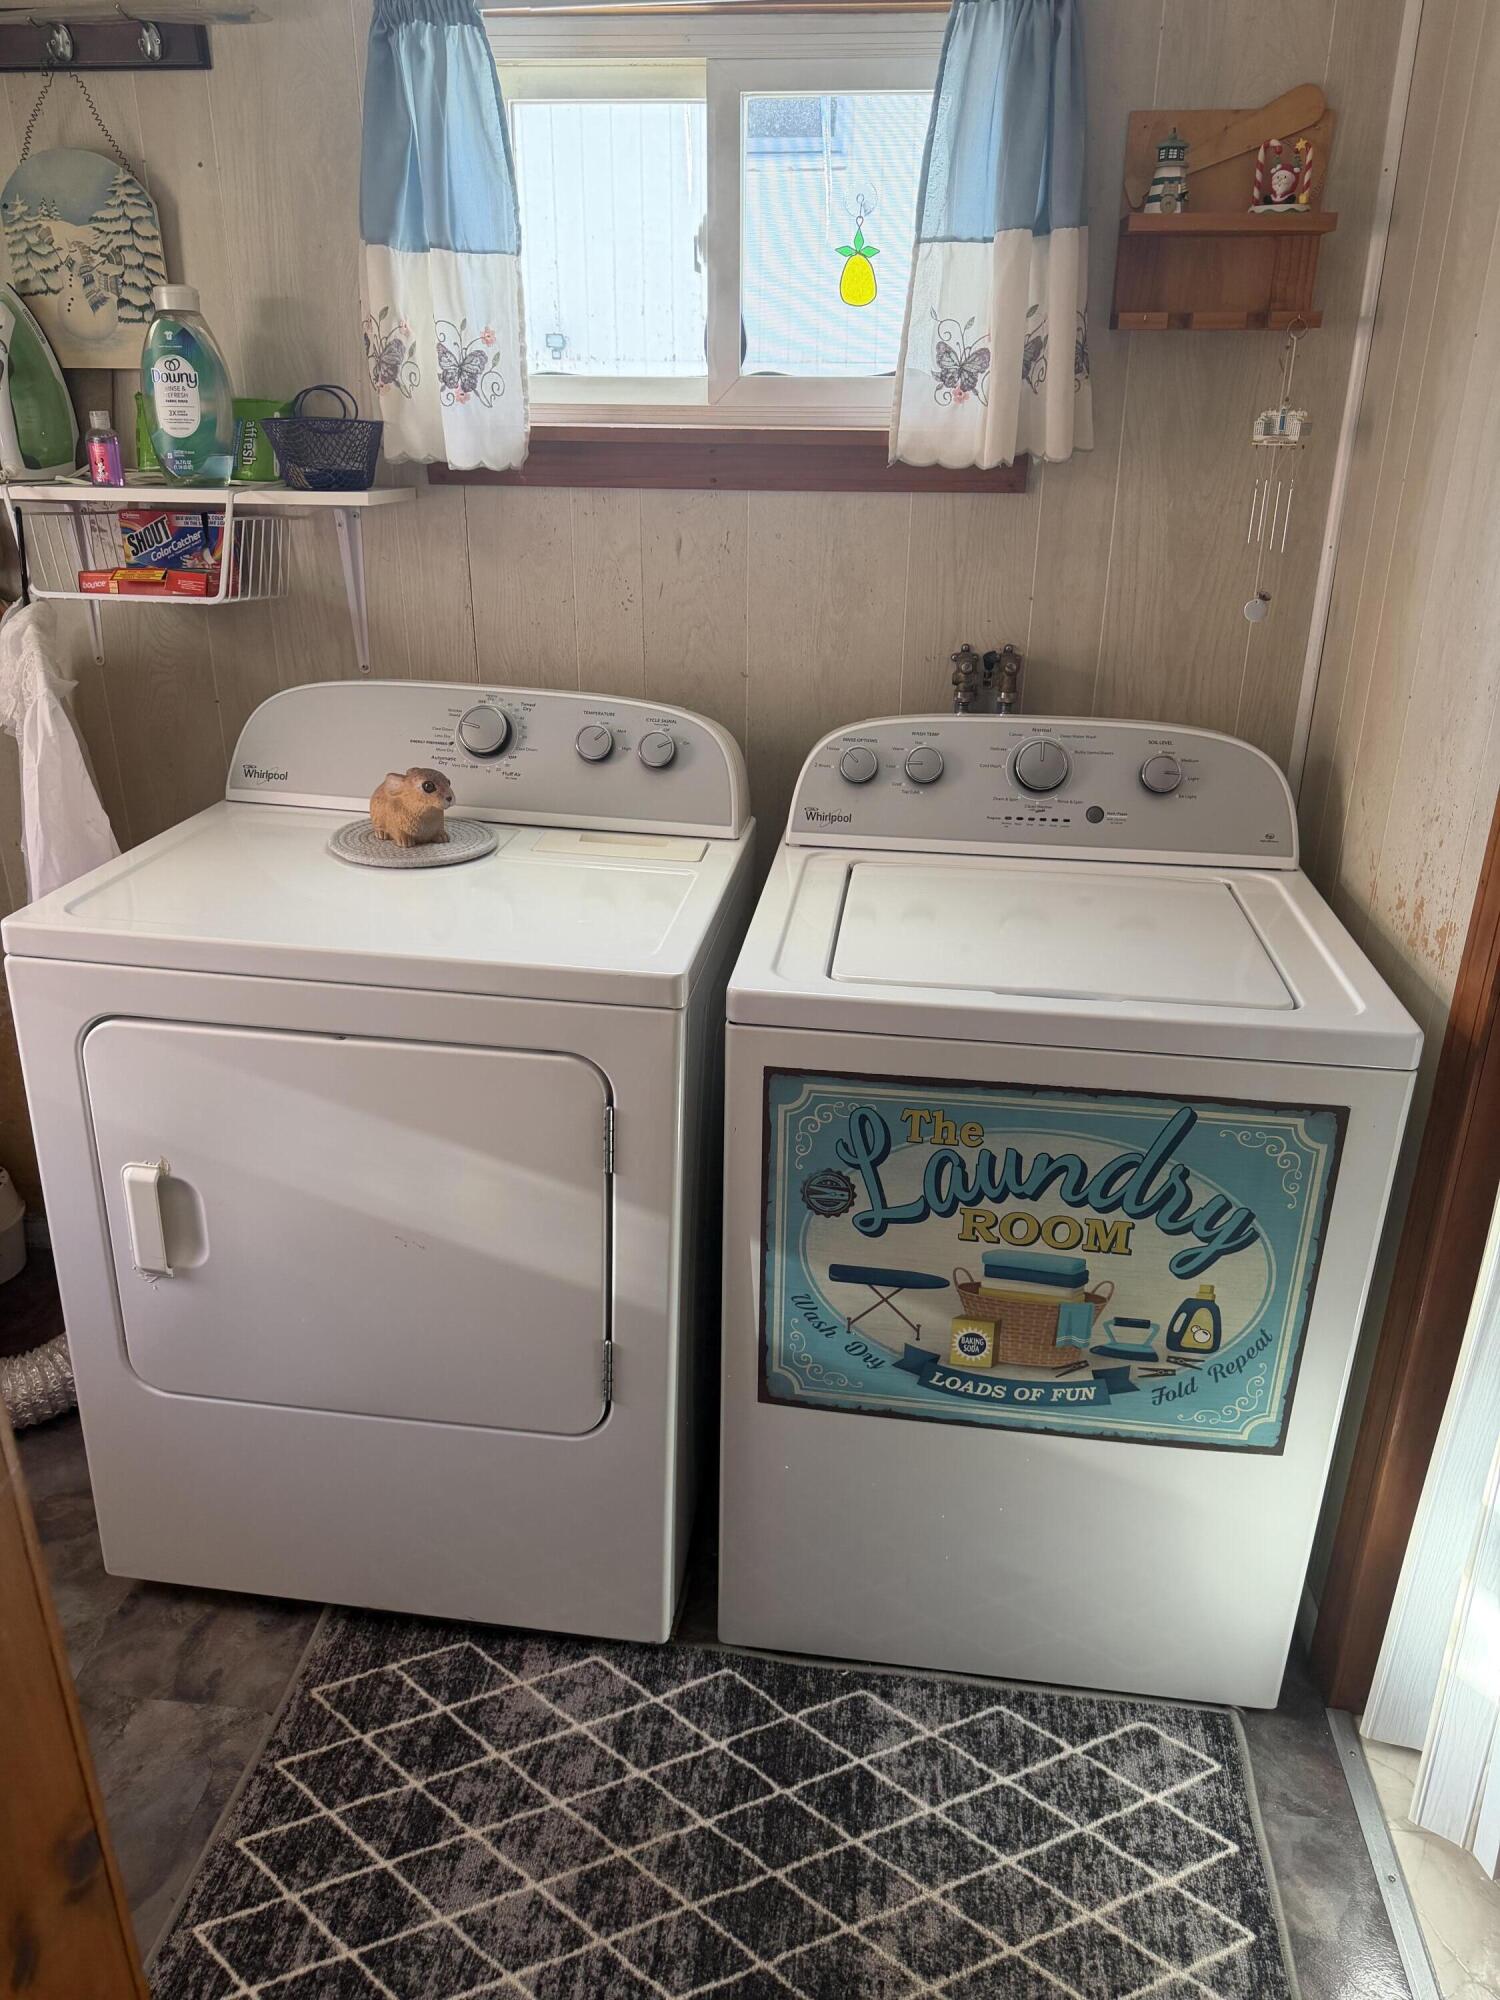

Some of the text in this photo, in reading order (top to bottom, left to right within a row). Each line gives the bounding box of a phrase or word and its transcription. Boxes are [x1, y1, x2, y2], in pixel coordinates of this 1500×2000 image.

[152, 368, 198, 389] Downy
[243, 420, 258, 465] affresh
[127, 516, 172, 557] SHOUT
[151, 530, 202, 561] ColorCatcher
[83, 580, 106, 589] bounce
[244, 768, 288, 782] Whirlpool
[805, 810, 852, 824] Whirlpool
[900, 1107, 985, 1148] The
[835, 1105, 1261, 1280] Laundry
[957, 1206, 1135, 1256] ROOM
[791, 1293, 886, 1371] Wash Dry
[960, 1336, 984, 1347] BAKING
[963, 1343, 980, 1354] SODA
[1151, 1327, 1273, 1406] Fold Repeat
[929, 1372, 1096, 1402] LOADS OF FUN
